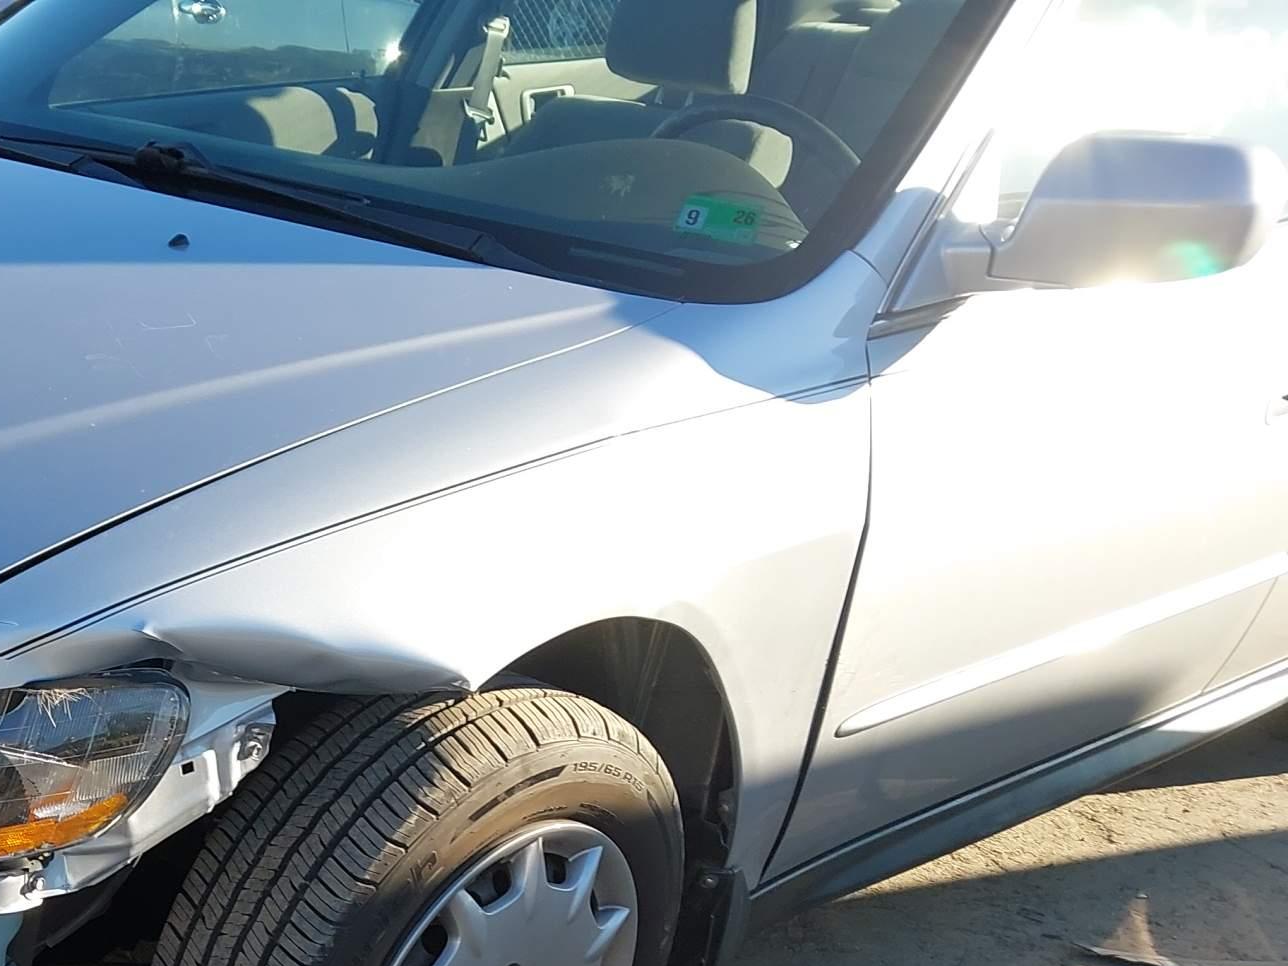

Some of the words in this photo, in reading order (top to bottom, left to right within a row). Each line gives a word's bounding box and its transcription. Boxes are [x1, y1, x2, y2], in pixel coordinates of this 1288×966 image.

[685, 209, 700, 225] 9
[733, 210, 756, 226] 26
[573, 762, 622, 777] 195/65
